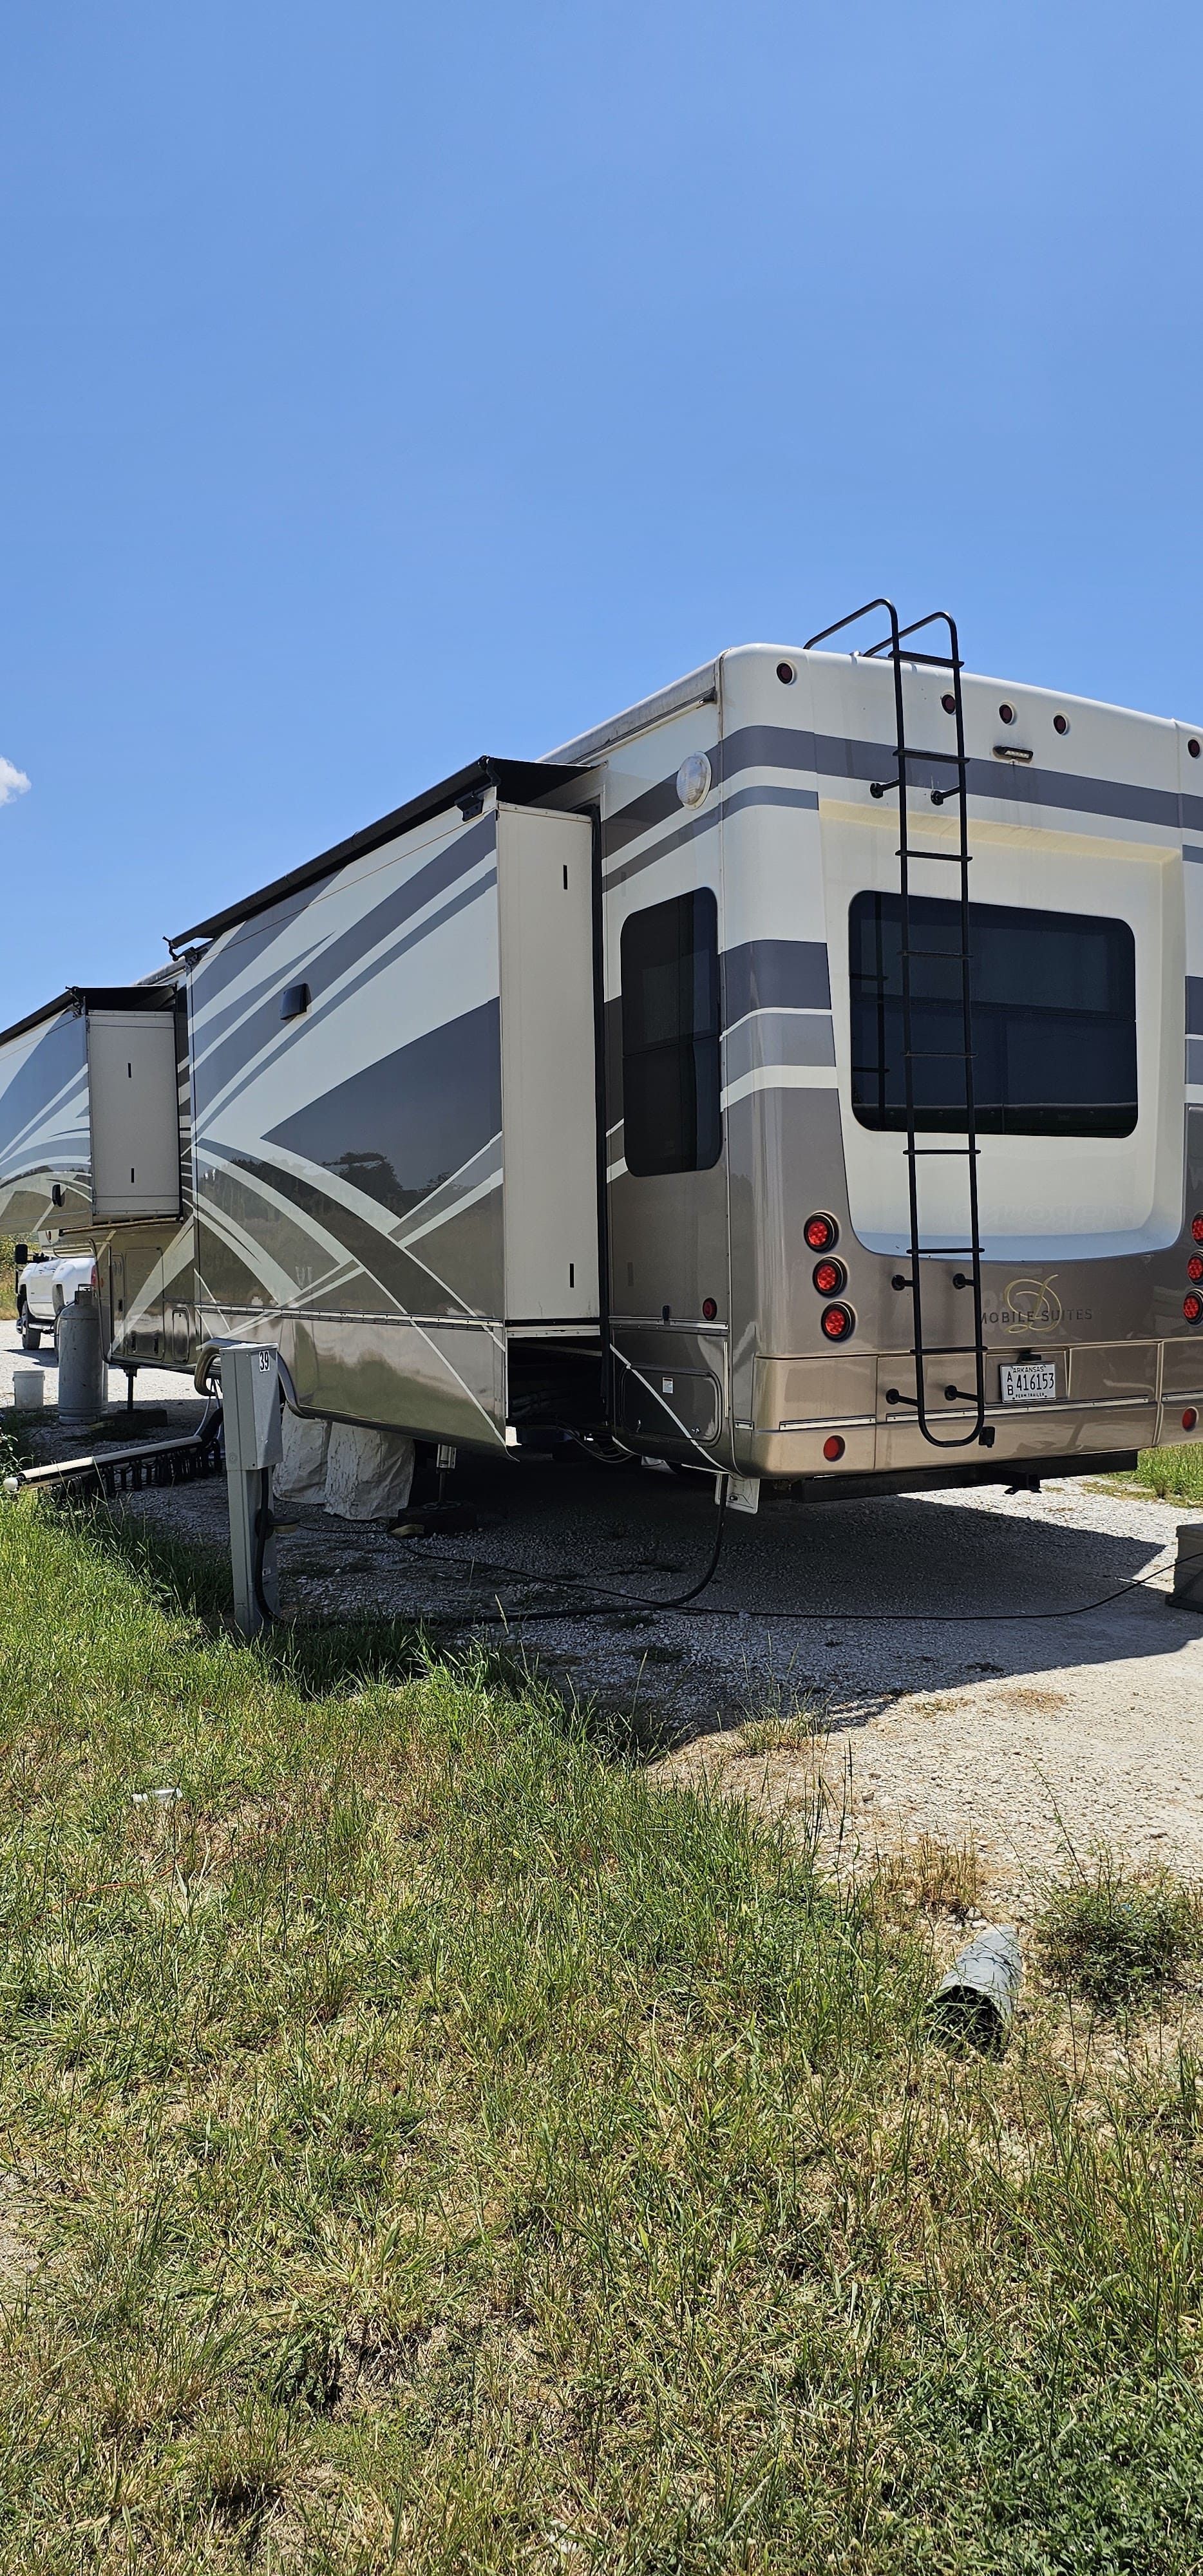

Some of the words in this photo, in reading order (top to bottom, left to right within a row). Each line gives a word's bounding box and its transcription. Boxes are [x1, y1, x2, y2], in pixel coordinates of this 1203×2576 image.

[1041, 1309, 1092, 1321] SUITES
[260, 1352, 269, 1370] 39
[1016, 1372, 1054, 1391] 416153
